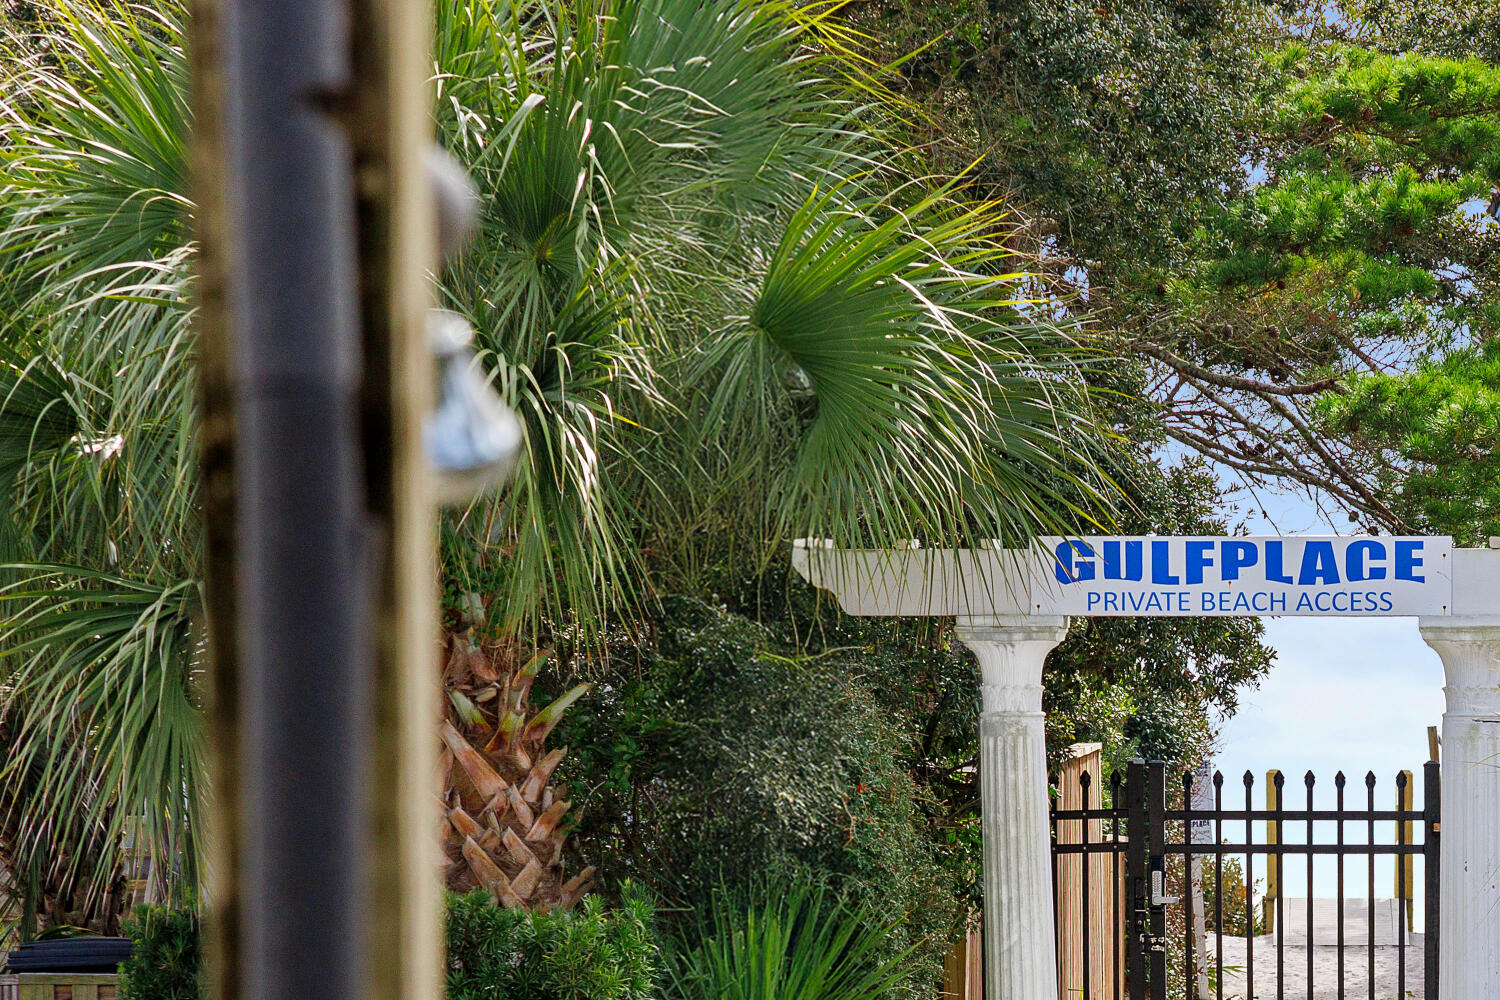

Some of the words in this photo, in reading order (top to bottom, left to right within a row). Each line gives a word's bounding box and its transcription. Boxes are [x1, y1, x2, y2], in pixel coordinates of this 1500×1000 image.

[1054, 540, 1426, 585] GULFPLACE
[1087, 591, 1191, 612] PRIVATE
[1201, 591, 1286, 612] BEACH
[1296, 591, 1393, 612] ACCESS
